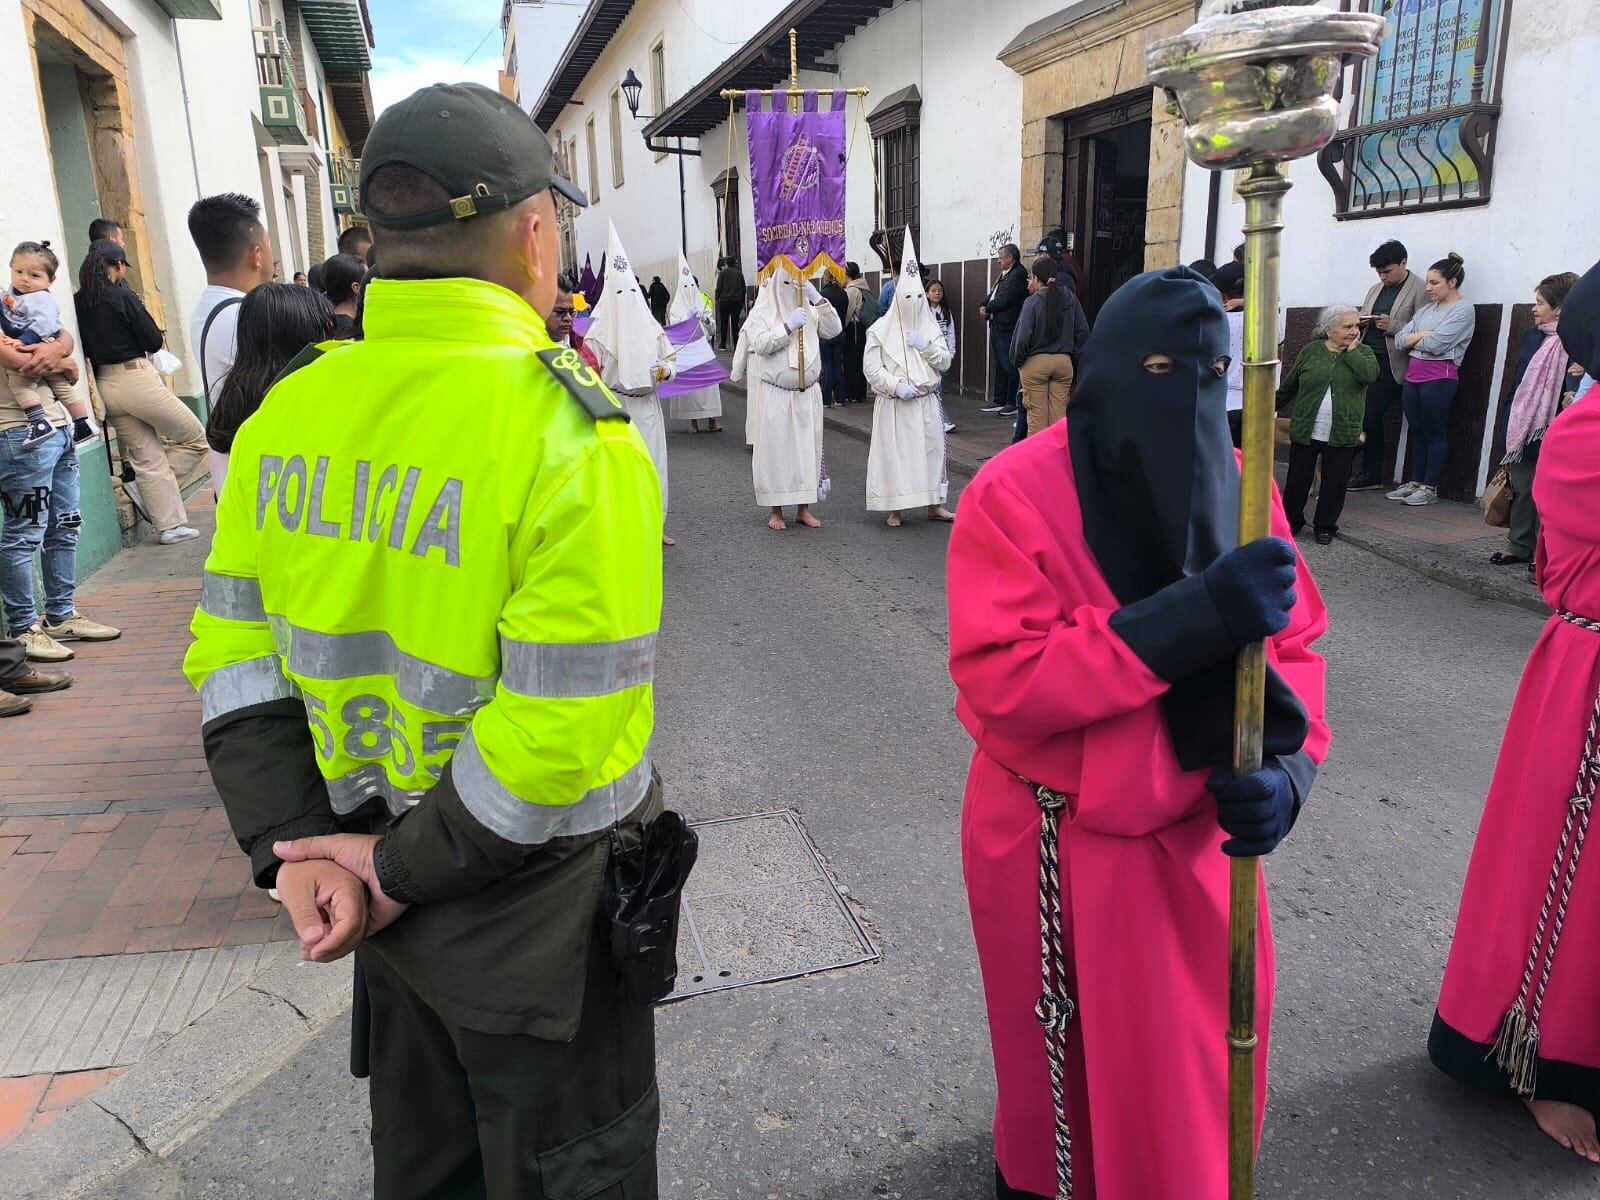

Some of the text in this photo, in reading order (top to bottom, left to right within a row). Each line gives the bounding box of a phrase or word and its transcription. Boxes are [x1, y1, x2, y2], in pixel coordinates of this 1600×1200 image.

[1426, 12, 1468, 33] CHCOLAES
[1407, 49, 1430, 63] DLCES
[256, 454, 463, 568] POLICIA
